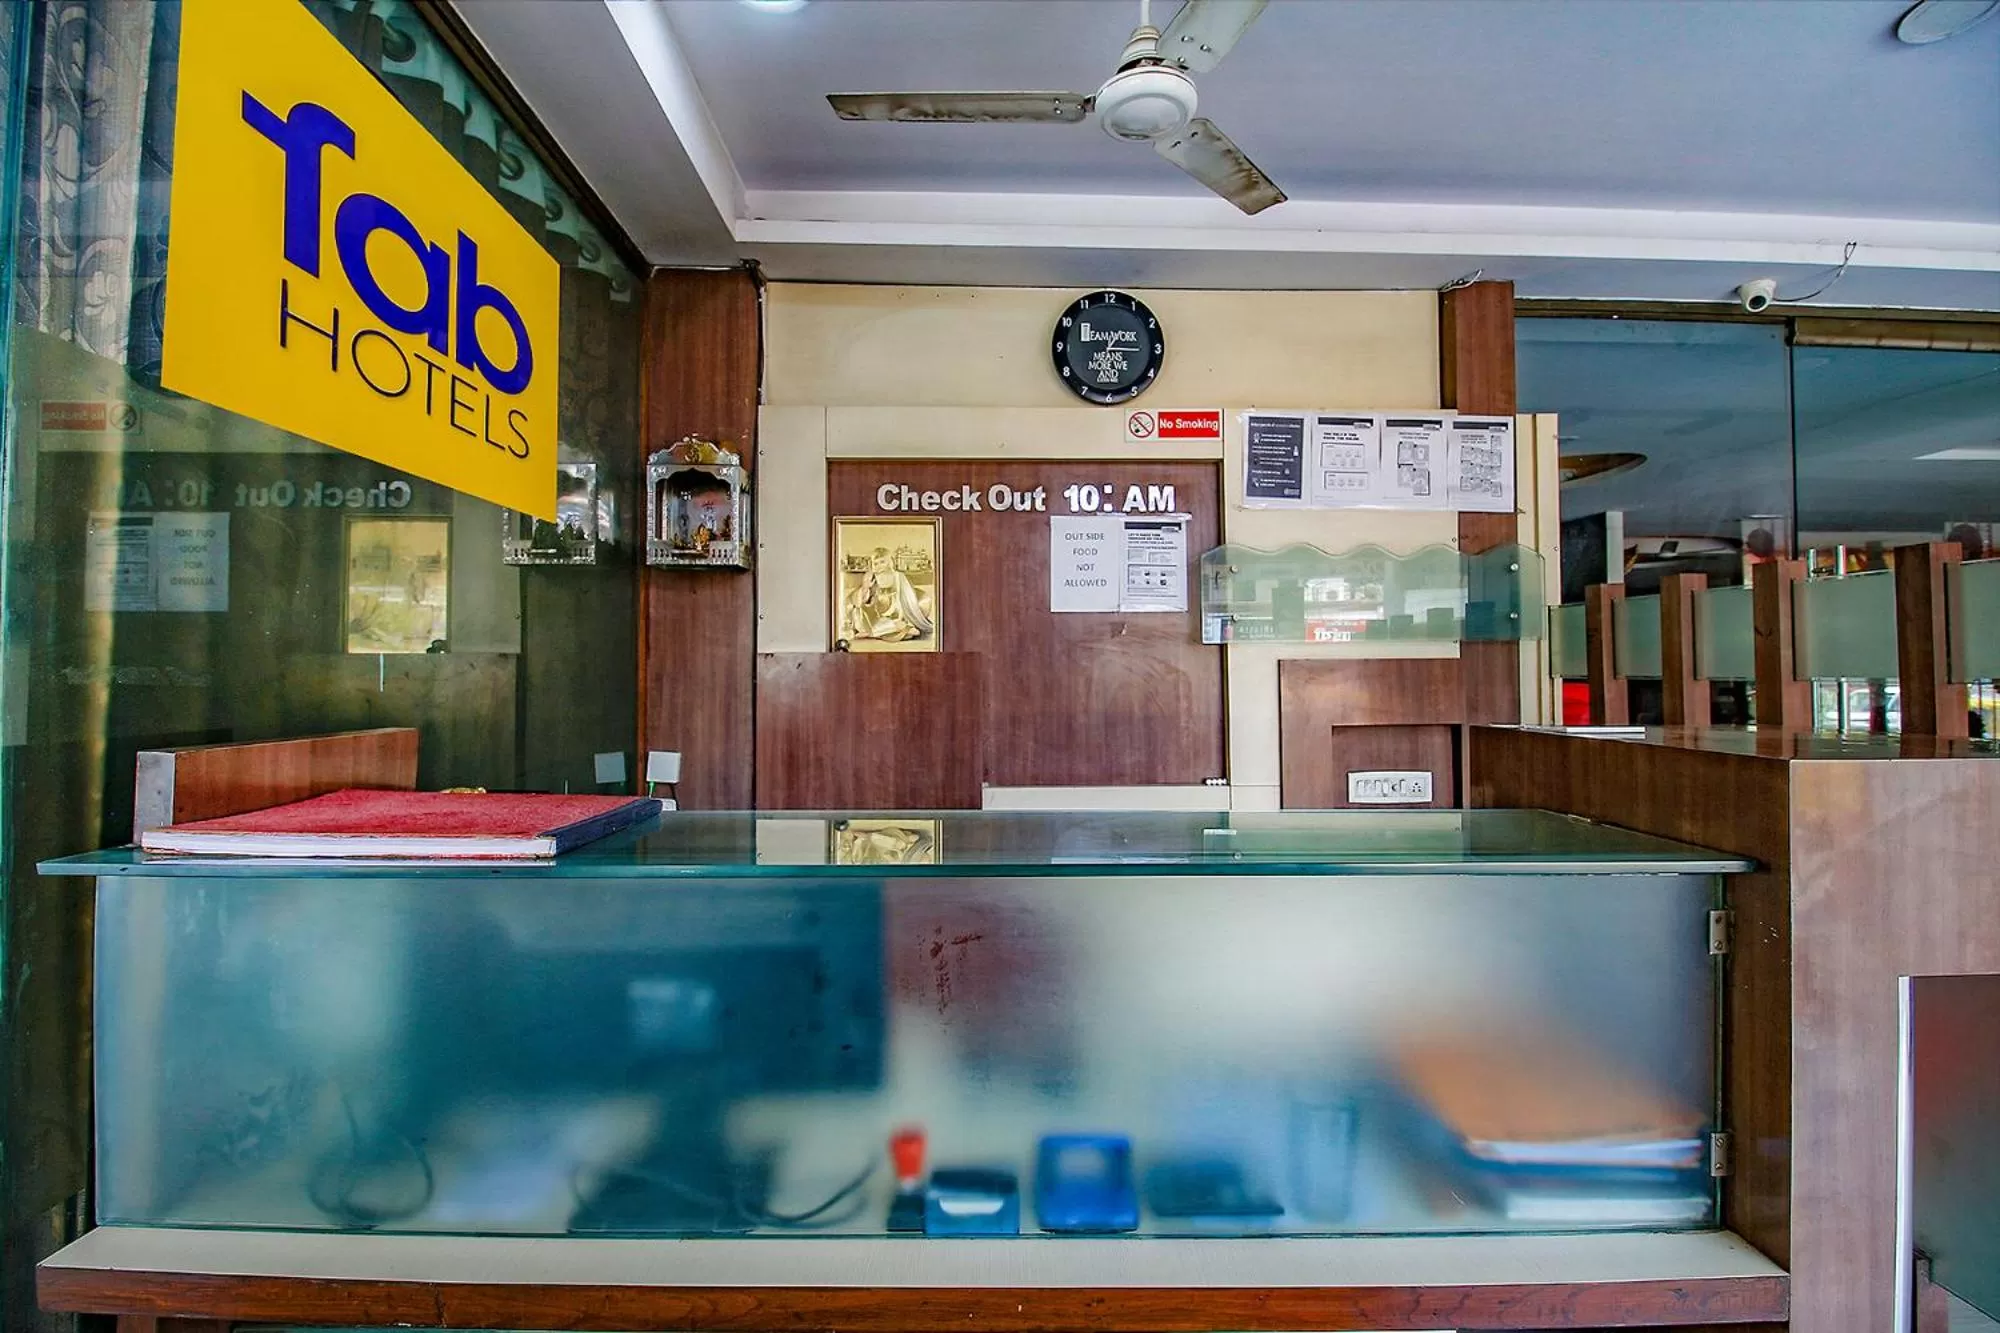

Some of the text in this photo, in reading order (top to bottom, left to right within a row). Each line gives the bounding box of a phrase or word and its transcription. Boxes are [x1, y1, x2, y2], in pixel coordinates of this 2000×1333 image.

[1104, 293, 1116, 304] 12
[1080, 299, 1089, 309] 11
[1061, 317, 1072, 327] 10
[1149, 318, 1156, 329] 2
[1056, 342, 1064, 353] 9
[1154, 344, 1162, 354] 3
[1092, 351, 1123, 361] MEANS
[279, 277, 530, 460] HOTELS
[1087, 361, 1128, 371] MORE WE
[1063, 366, 1070, 377] 8
[1098, 370, 1119, 379] AND
[1147, 368, 1155, 378] 4
[1081, 386, 1088, 395] 7
[1131, 386, 1138, 397] 5
[1105, 393, 1113, 403] 6
[1160, 418, 1219, 431] No Smoking
[876, 483, 1176, 513] Check Out 10: AM
[1064, 532, 1105, 541] OUT SIDE
[1072, 547, 1098, 556] FOOD
[1075, 563, 1095, 571] NOT
[1064, 579, 1108, 587] ALLOWED
